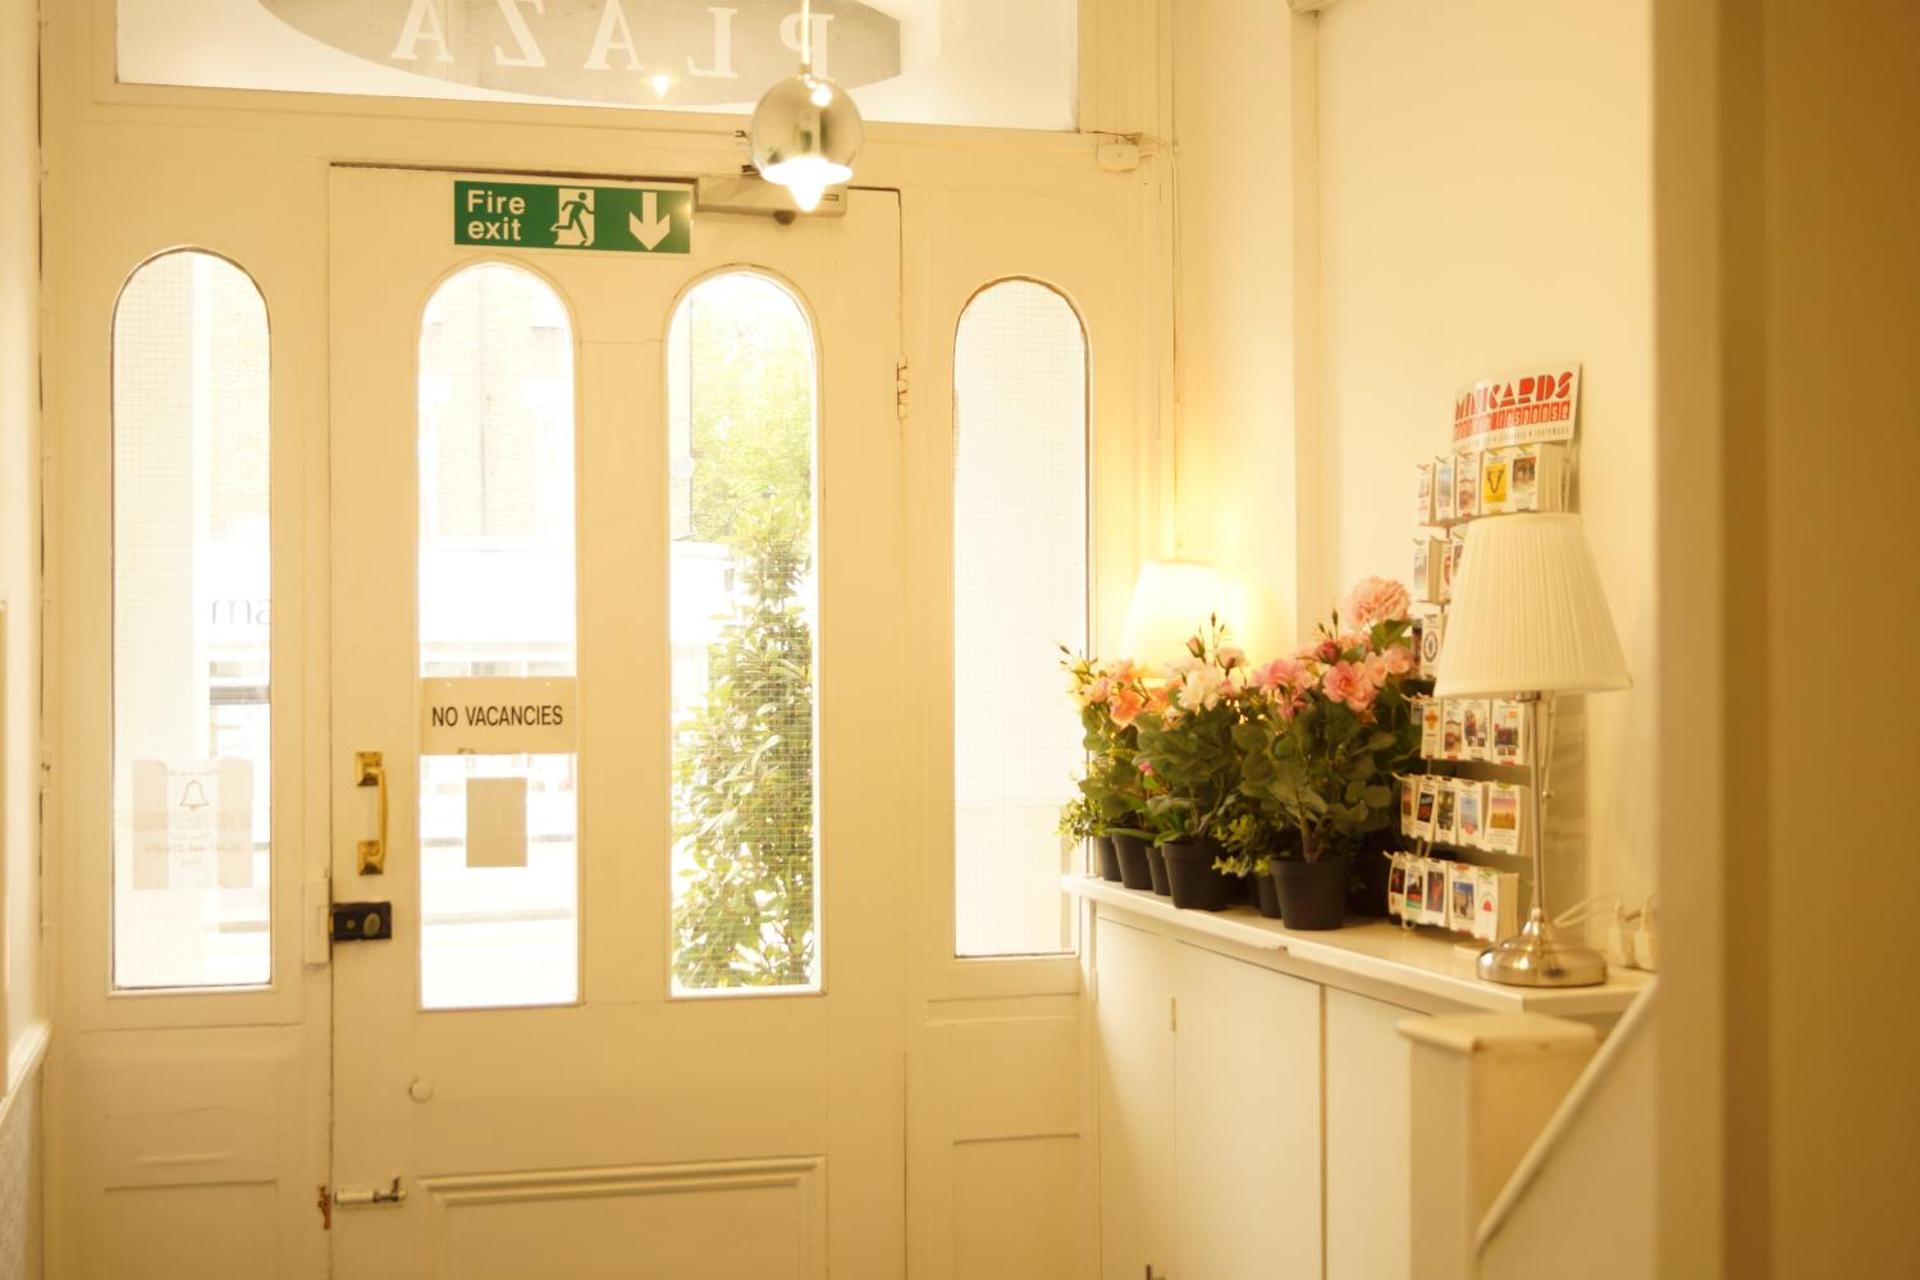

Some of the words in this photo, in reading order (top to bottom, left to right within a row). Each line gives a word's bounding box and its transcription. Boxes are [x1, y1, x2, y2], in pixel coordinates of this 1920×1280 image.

[467, 189, 526, 215] Fire
[467, 217, 522, 241] exit
[432, 706, 458, 727] NO
[466, 705, 564, 727] VACANCIES
